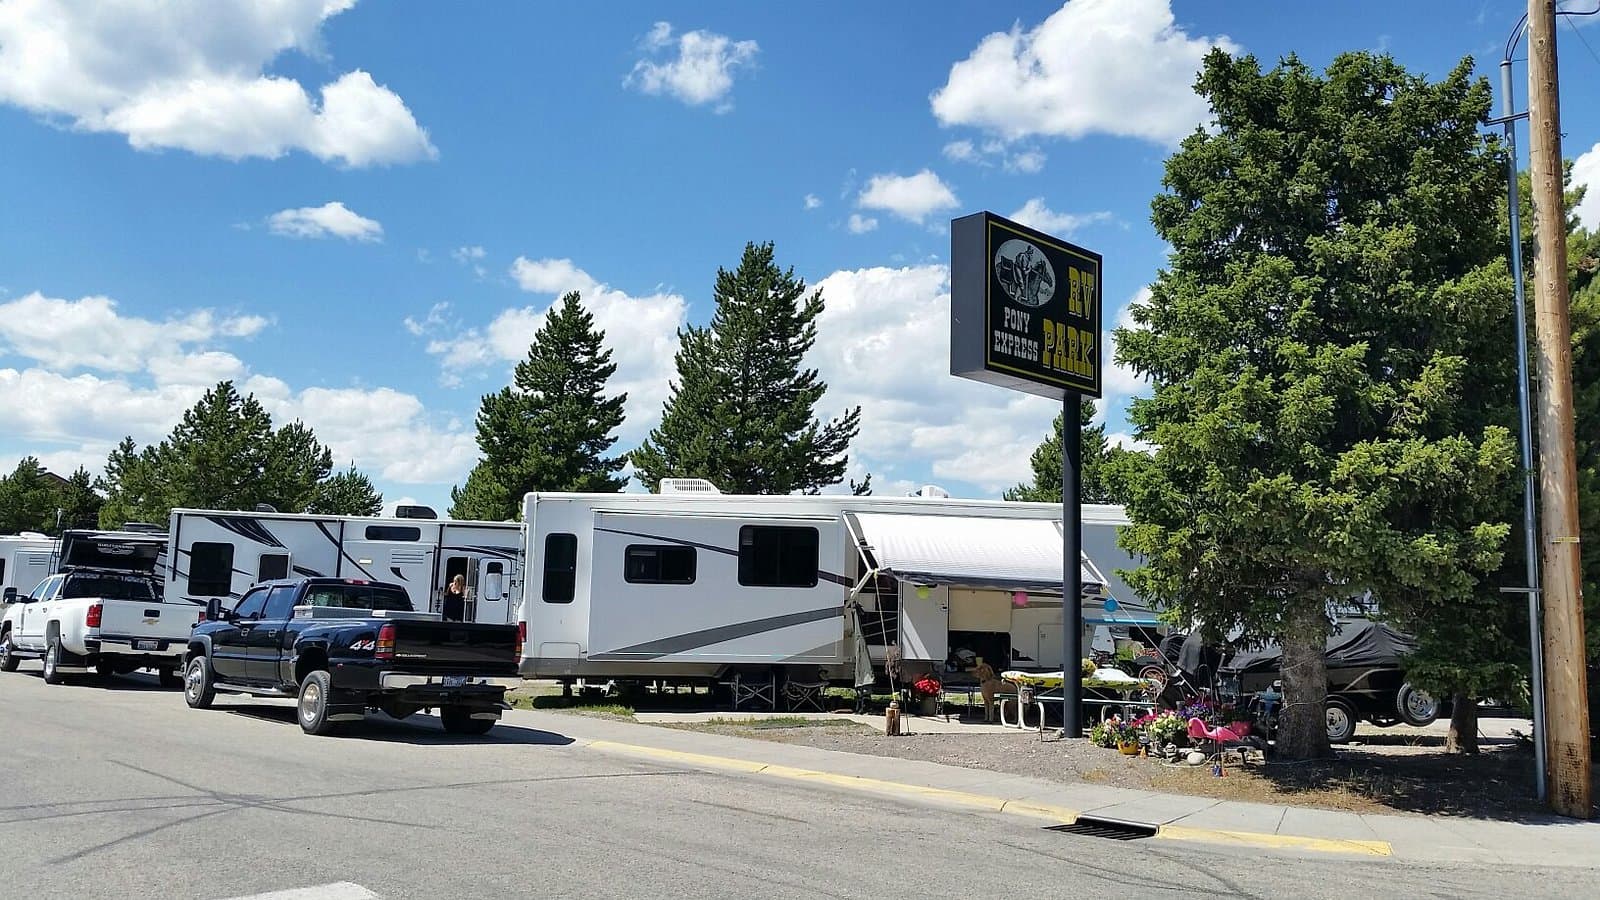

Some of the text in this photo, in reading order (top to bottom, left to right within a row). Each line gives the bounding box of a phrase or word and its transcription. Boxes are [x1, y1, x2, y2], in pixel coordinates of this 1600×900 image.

[1068, 266, 1094, 320] RV
[1004, 306, 1030, 333] PONY
[994, 330, 1038, 362] EXPRESS
[1043, 318, 1094, 380] PARK
